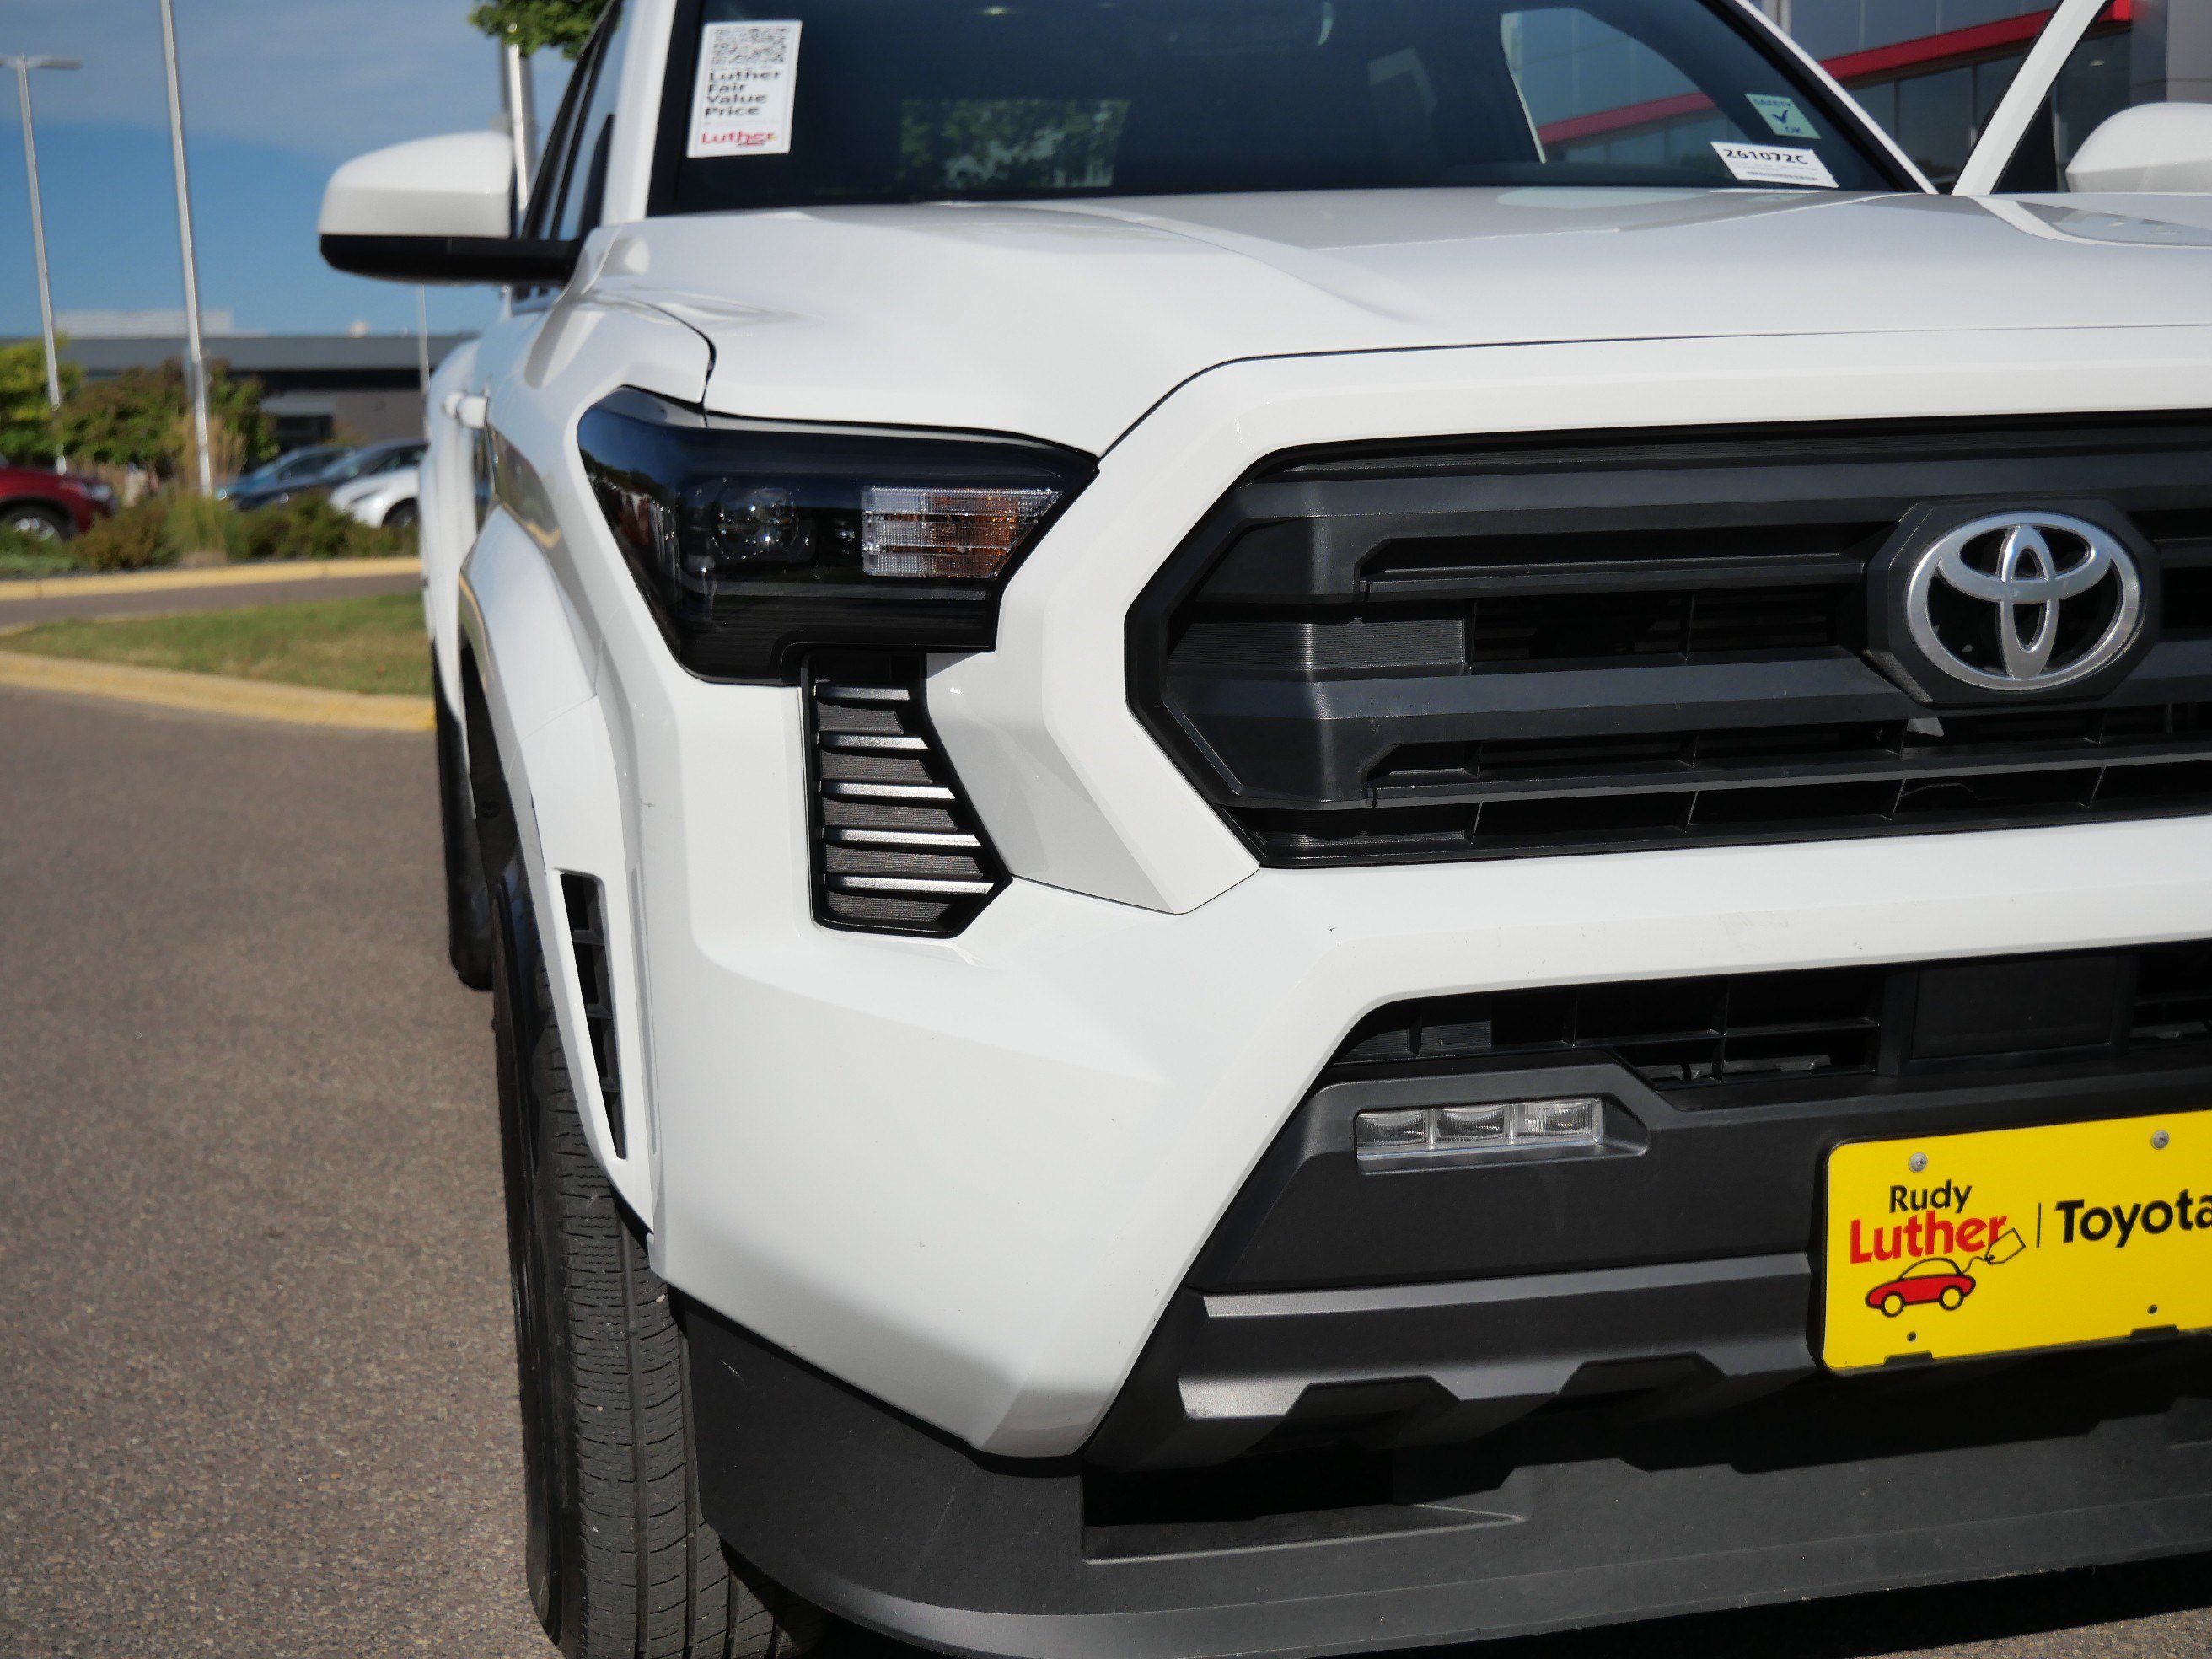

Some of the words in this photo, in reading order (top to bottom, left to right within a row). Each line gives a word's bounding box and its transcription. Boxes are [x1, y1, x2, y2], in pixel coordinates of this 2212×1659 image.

[710, 71, 781, 82] Luther
[708, 83, 747, 93] Fair
[706, 94, 768, 104] Value
[705, 106, 760, 117] Price
[1785, 126, 1801, 135] OK
[701, 130, 775, 146] Luther
[1723, 148, 1809, 164] 261072C
[1889, 1178, 1973, 1214] Rudy
[1850, 1211, 2008, 1264] Luther
